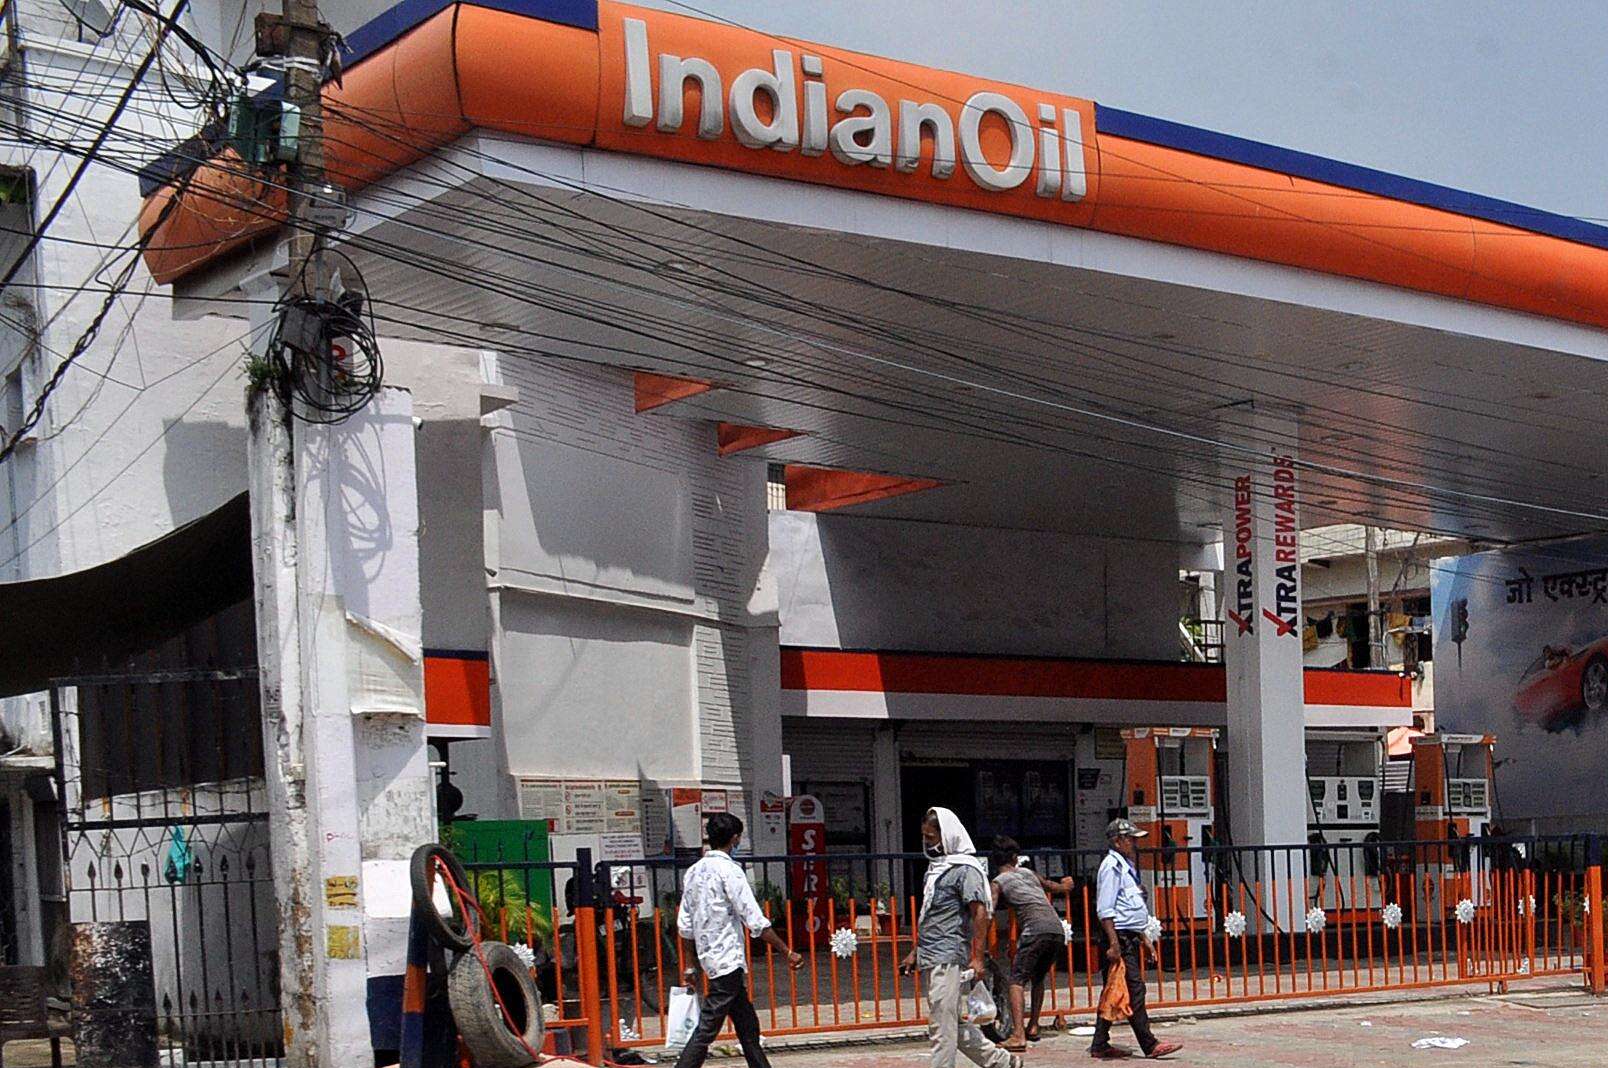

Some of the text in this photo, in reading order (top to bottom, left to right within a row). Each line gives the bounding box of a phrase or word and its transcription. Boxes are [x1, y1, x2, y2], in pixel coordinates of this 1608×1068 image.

[622, 17, 1087, 202] IndianOil
[1228, 474, 1254, 638] XTRAPOWER
[1263, 455, 1298, 637] XTRAREWARDS
[1505, 567, 1533, 604] जो
